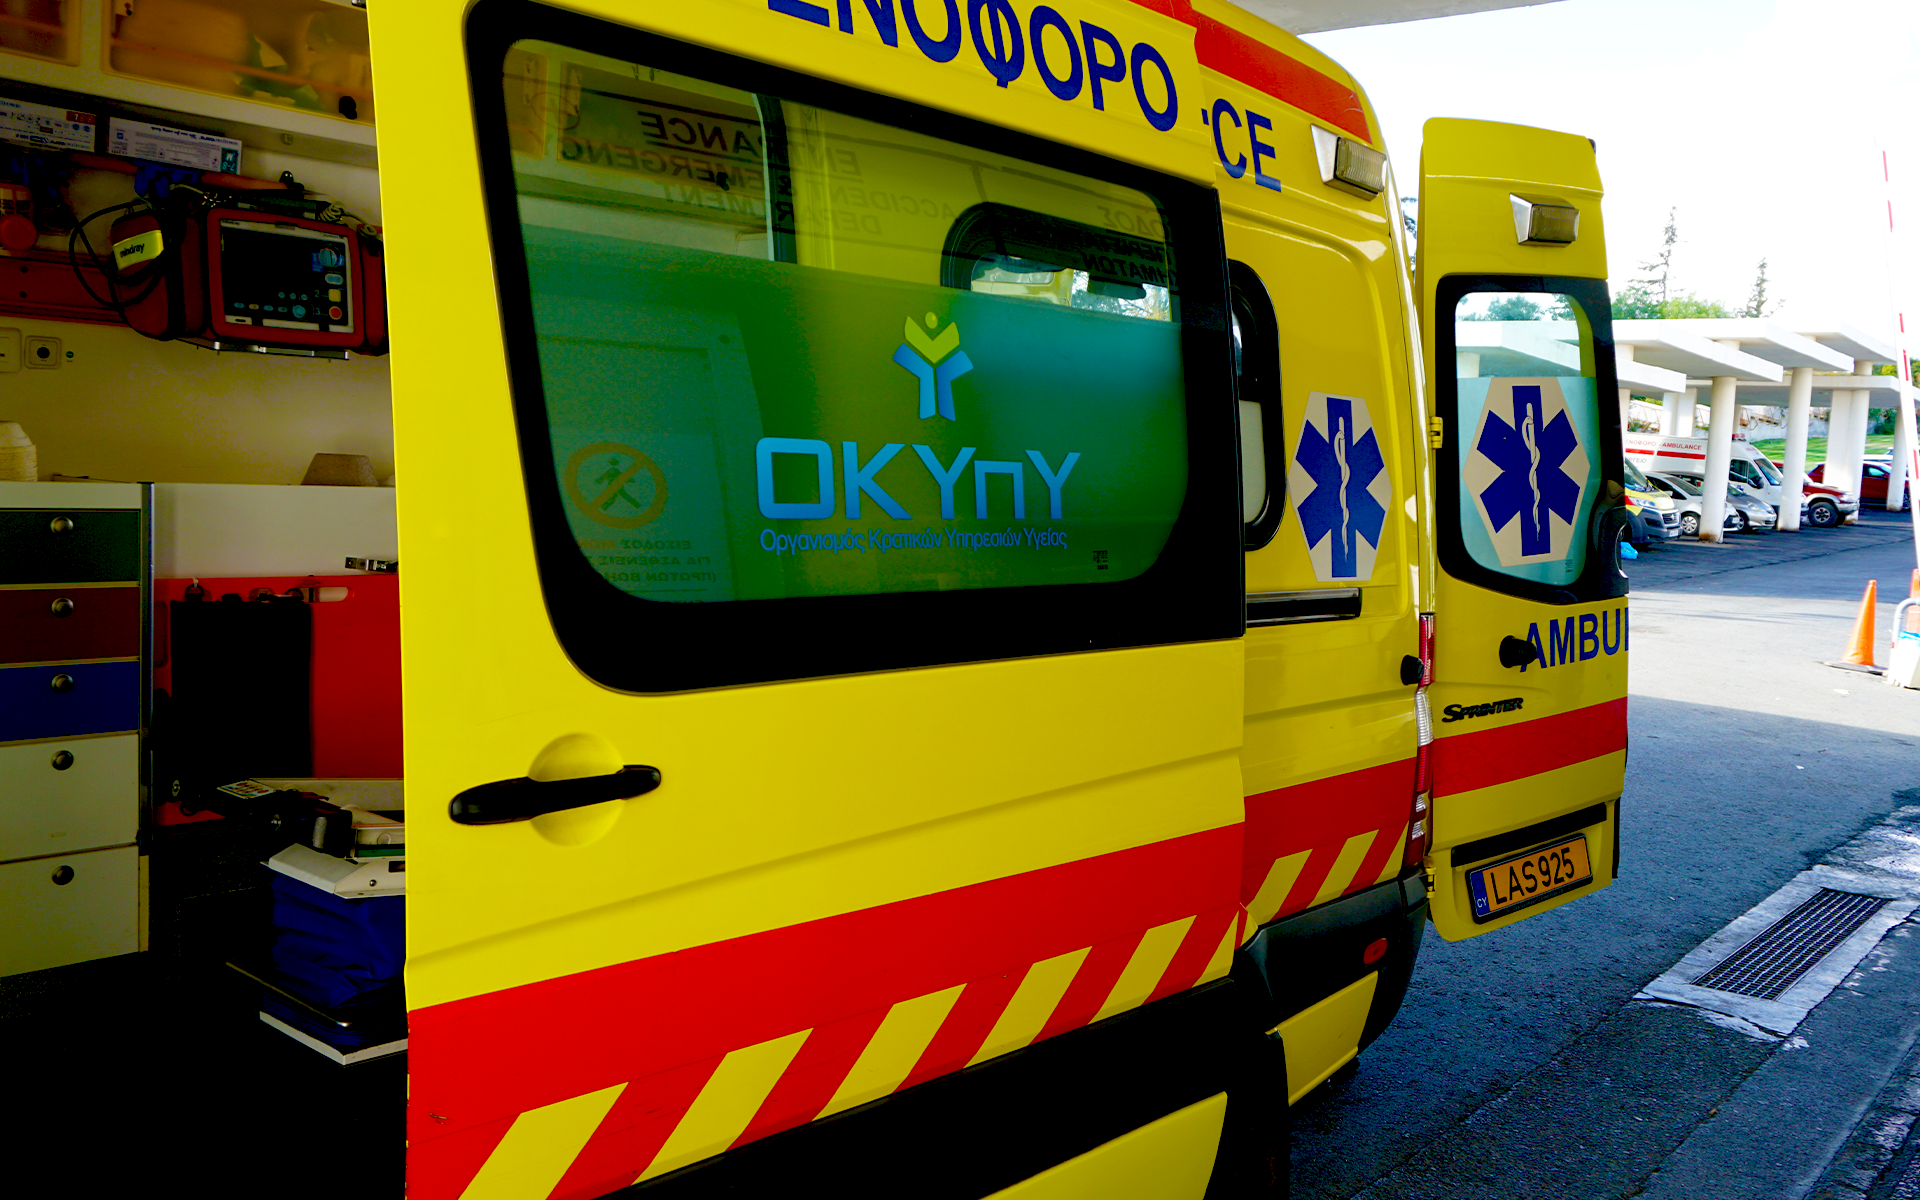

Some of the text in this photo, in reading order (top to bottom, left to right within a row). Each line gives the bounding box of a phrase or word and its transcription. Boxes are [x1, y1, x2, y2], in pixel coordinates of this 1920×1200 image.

[1201, 98, 1281, 192] CE
[1661, 442, 1702, 450] AMBULANCE
[760, 527, 1068, 556] Οργανισμός Κρατικών Υπηρεσιών Υγείας
[1490, 847, 1575, 905] LAS925
[1477, 897, 1487, 908] CY
